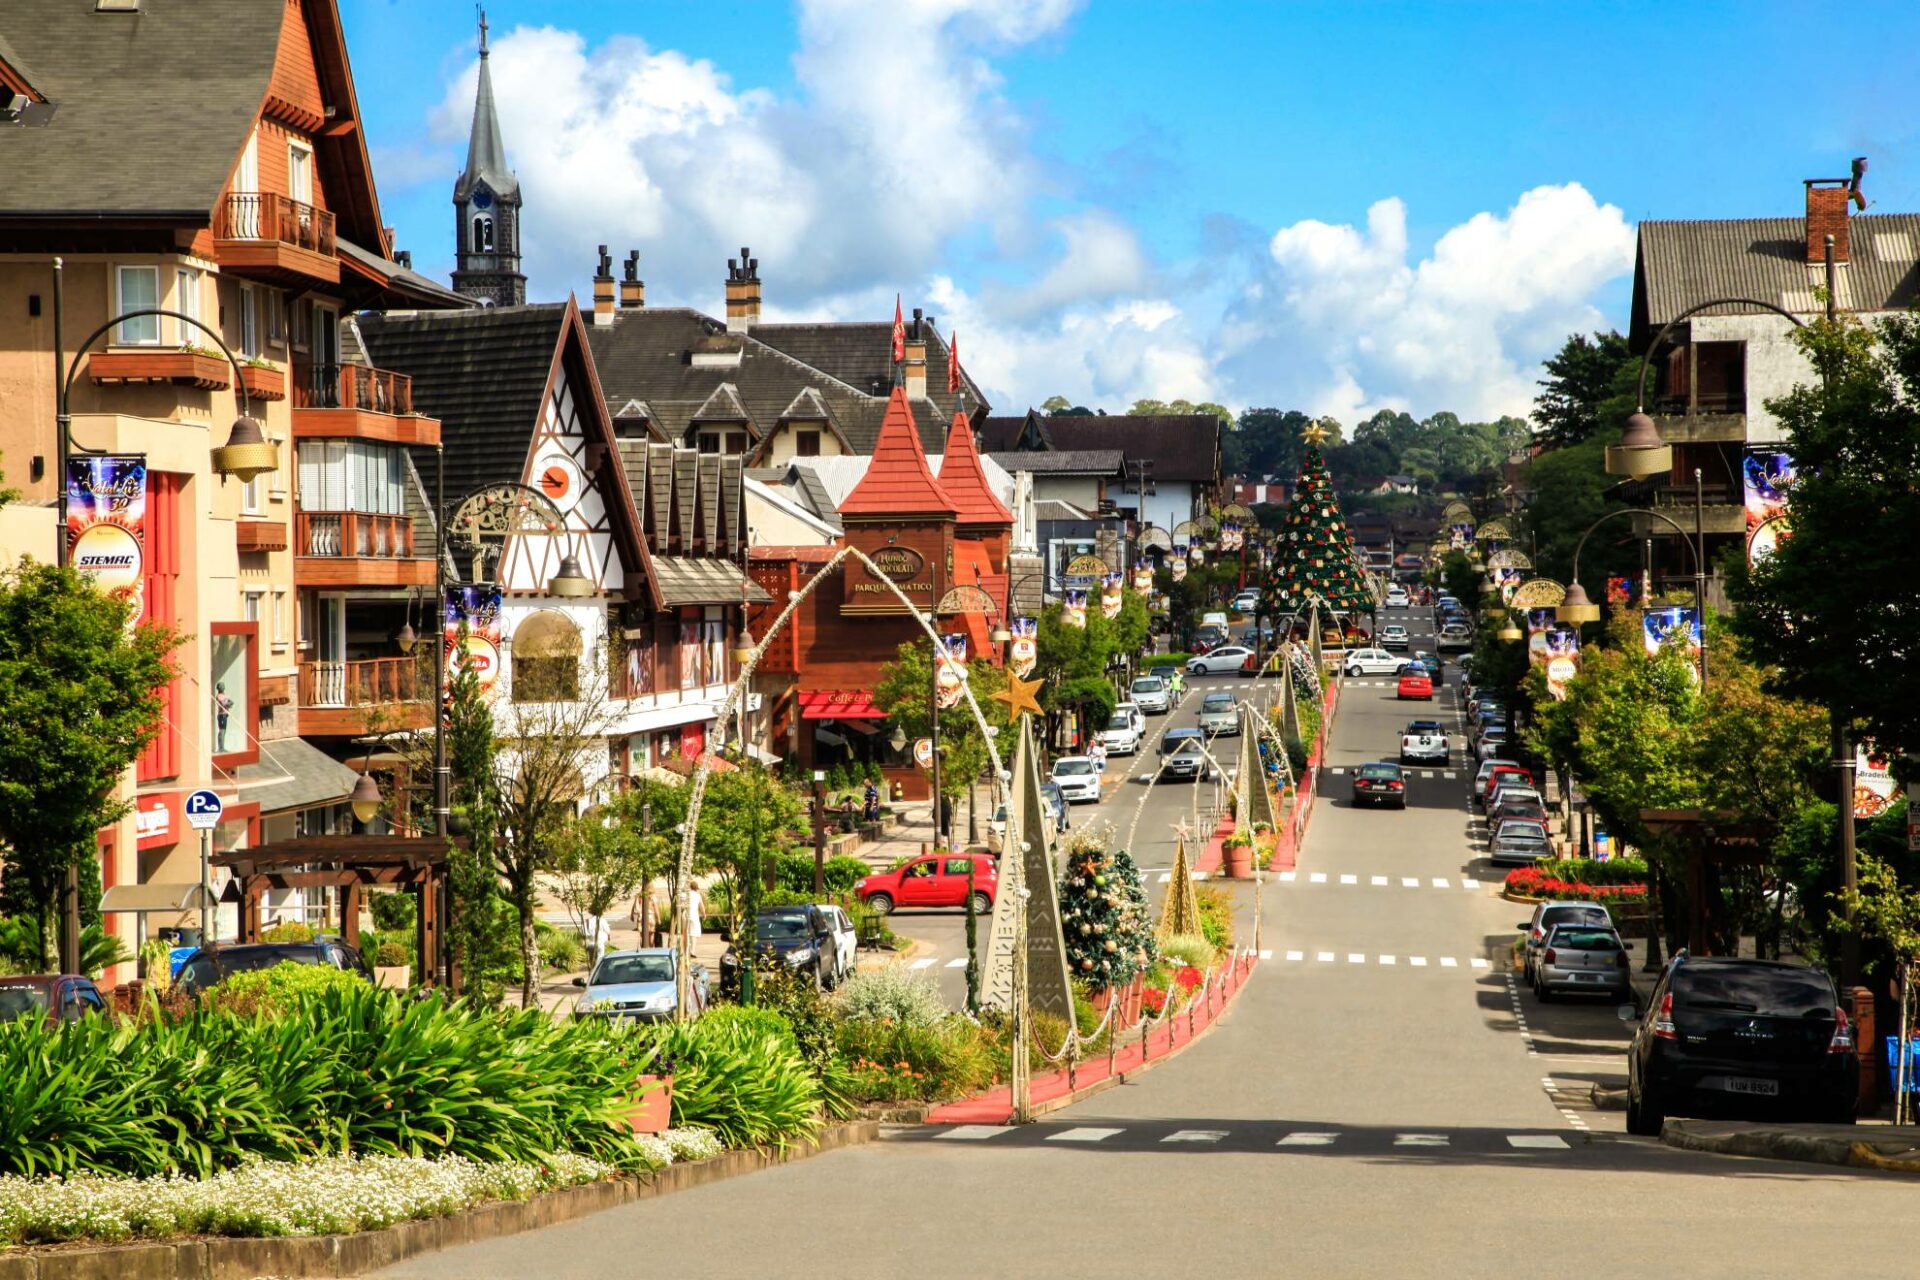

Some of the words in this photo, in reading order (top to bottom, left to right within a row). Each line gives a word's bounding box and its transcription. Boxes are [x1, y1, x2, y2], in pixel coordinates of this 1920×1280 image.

[82, 471, 119, 499] Natal
[122, 476, 143, 500] Luz
[109, 498, 128, 511] 30
[80, 555, 134, 565] STEMAC
[855, 584, 887, 592] PARQUE
[1860, 770, 1891, 778] Bradesc
[192, 795, 207, 813] P
